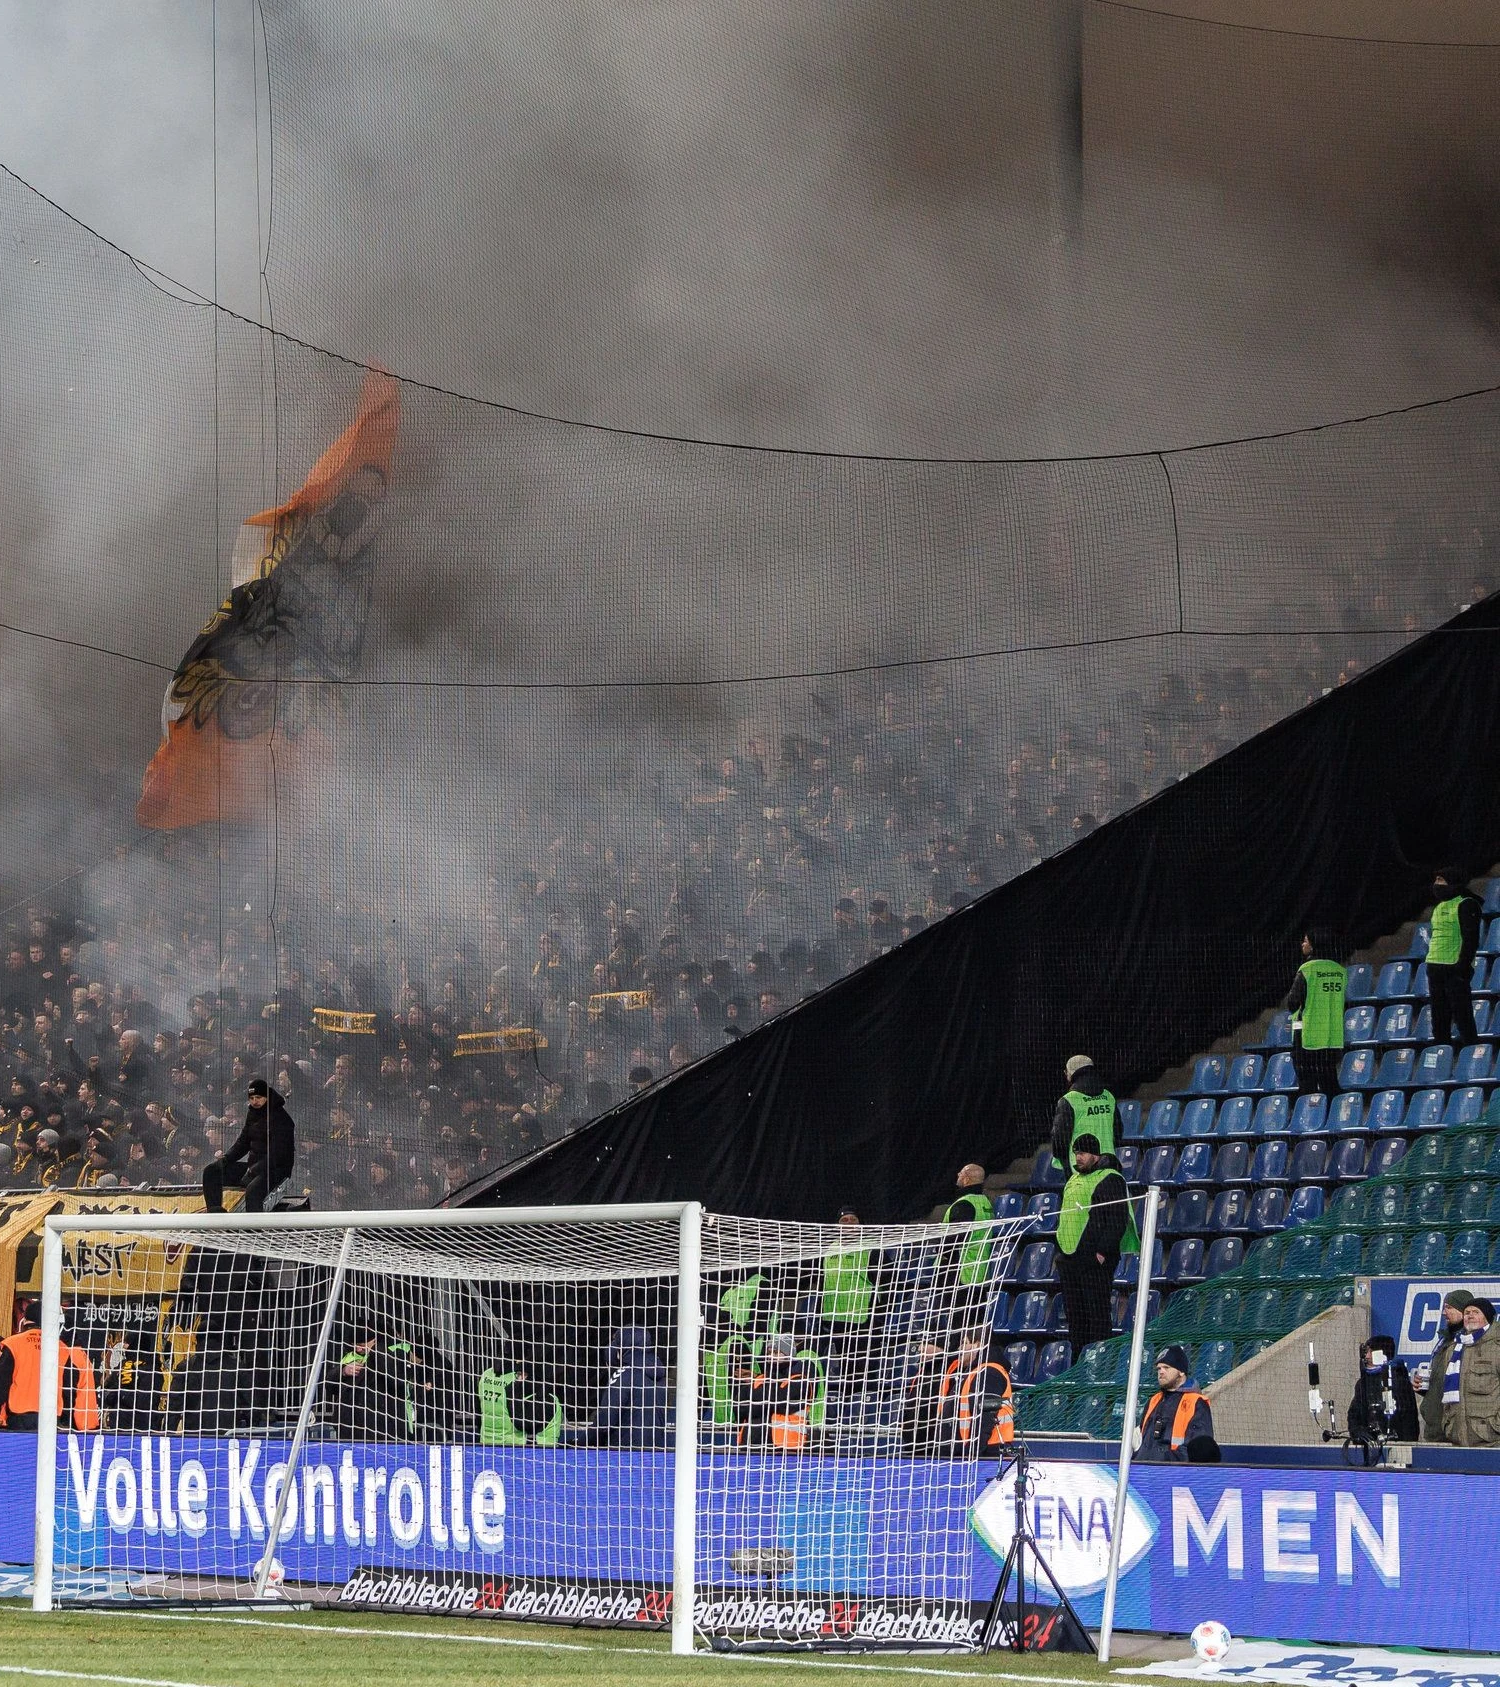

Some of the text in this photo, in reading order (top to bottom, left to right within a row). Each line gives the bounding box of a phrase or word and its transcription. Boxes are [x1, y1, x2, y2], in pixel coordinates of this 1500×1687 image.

[1322, 982, 1342, 993] 555
[1087, 1105, 1110, 1116] A055
[62, 1239, 137, 1282] WEST
[68, 1434, 507, 1553] Volle Kontrolle
[1172, 1486, 1402, 1589] MEN
[342, 1573, 510, 1612] dachbleche24
[505, 1583, 673, 1623] dachbleche24
[693, 1596, 863, 1635] achbleche24
